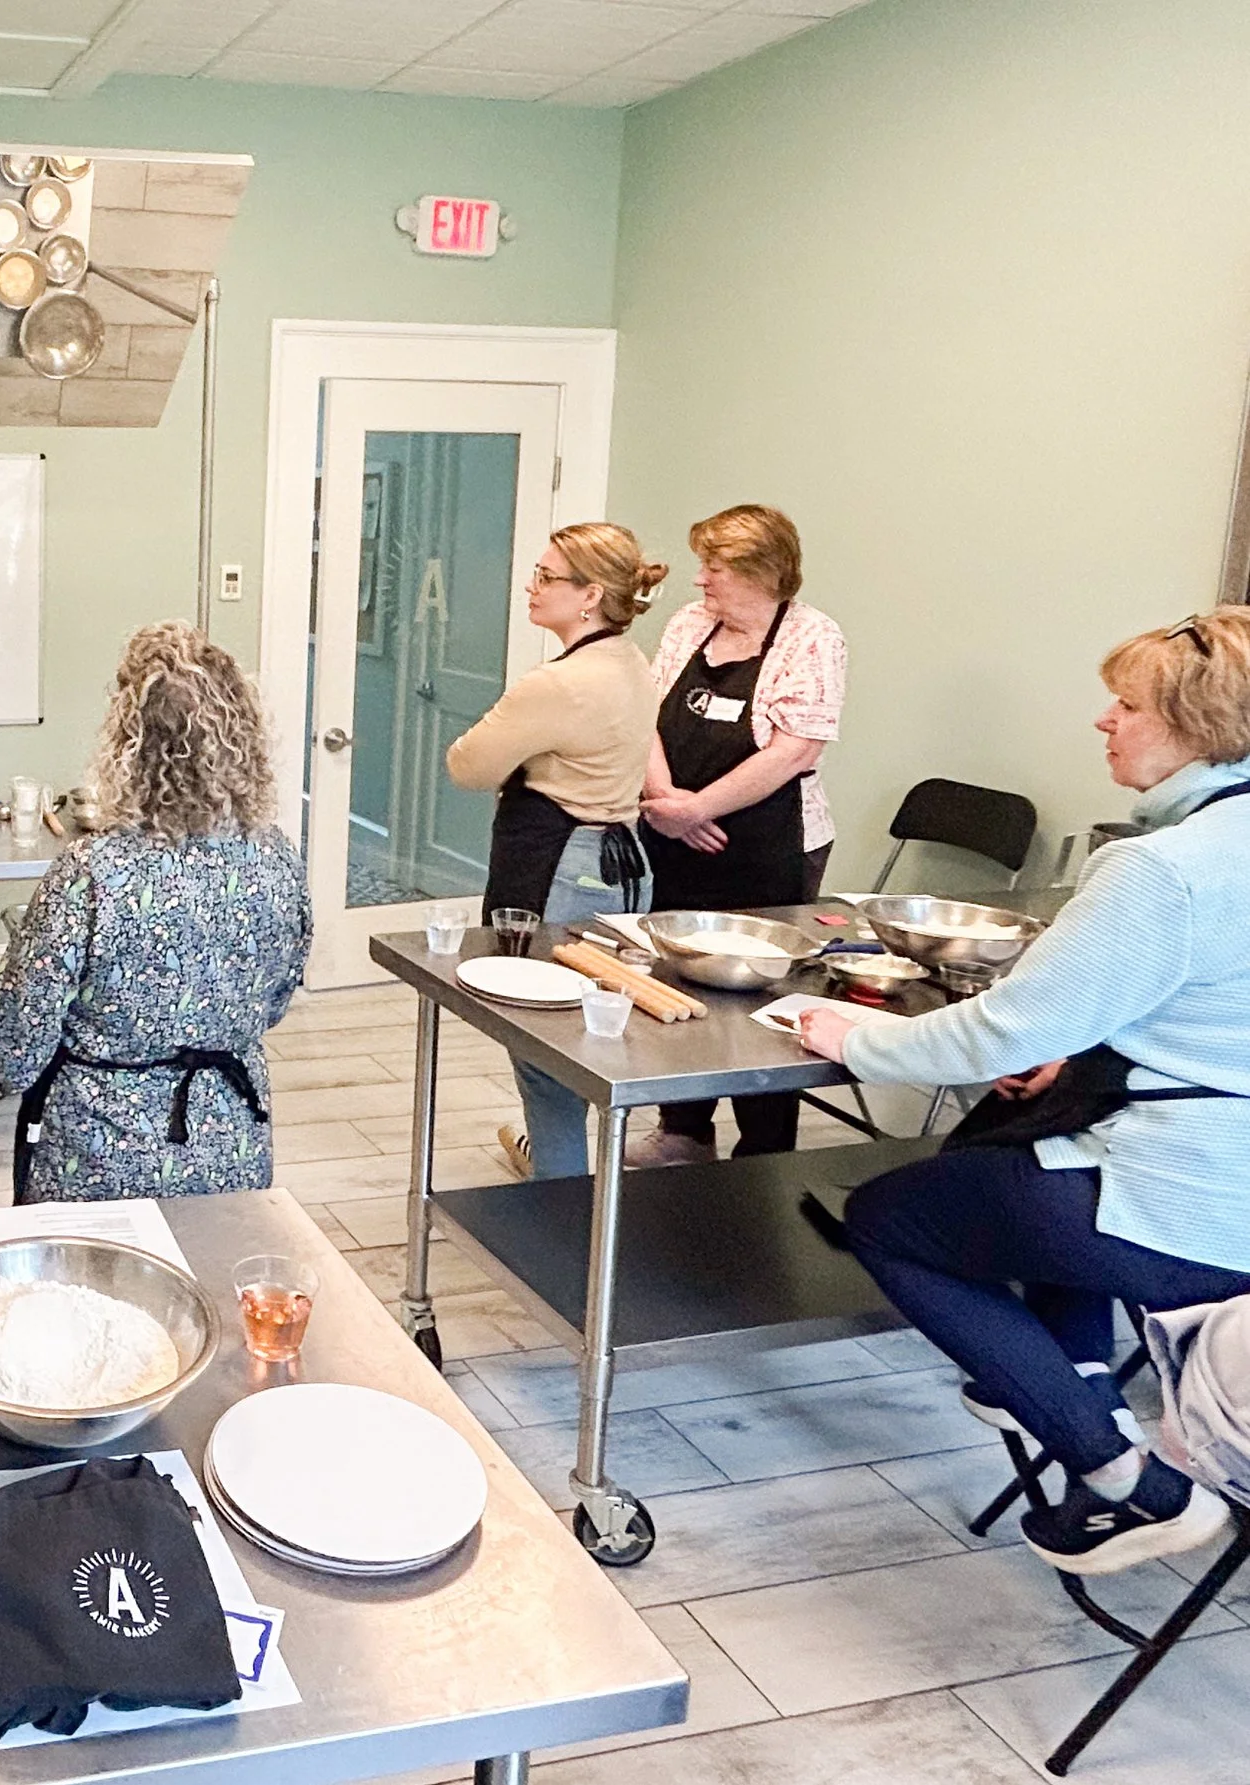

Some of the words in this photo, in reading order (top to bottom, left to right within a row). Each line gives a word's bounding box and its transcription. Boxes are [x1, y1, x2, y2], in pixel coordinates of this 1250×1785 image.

[432, 200, 490, 252] EXIT
[414, 558, 449, 623] A
[1084, 1512, 1116, 1533] S
[108, 1566, 147, 1625] A
[89, 1610, 120, 1635] AMIE
